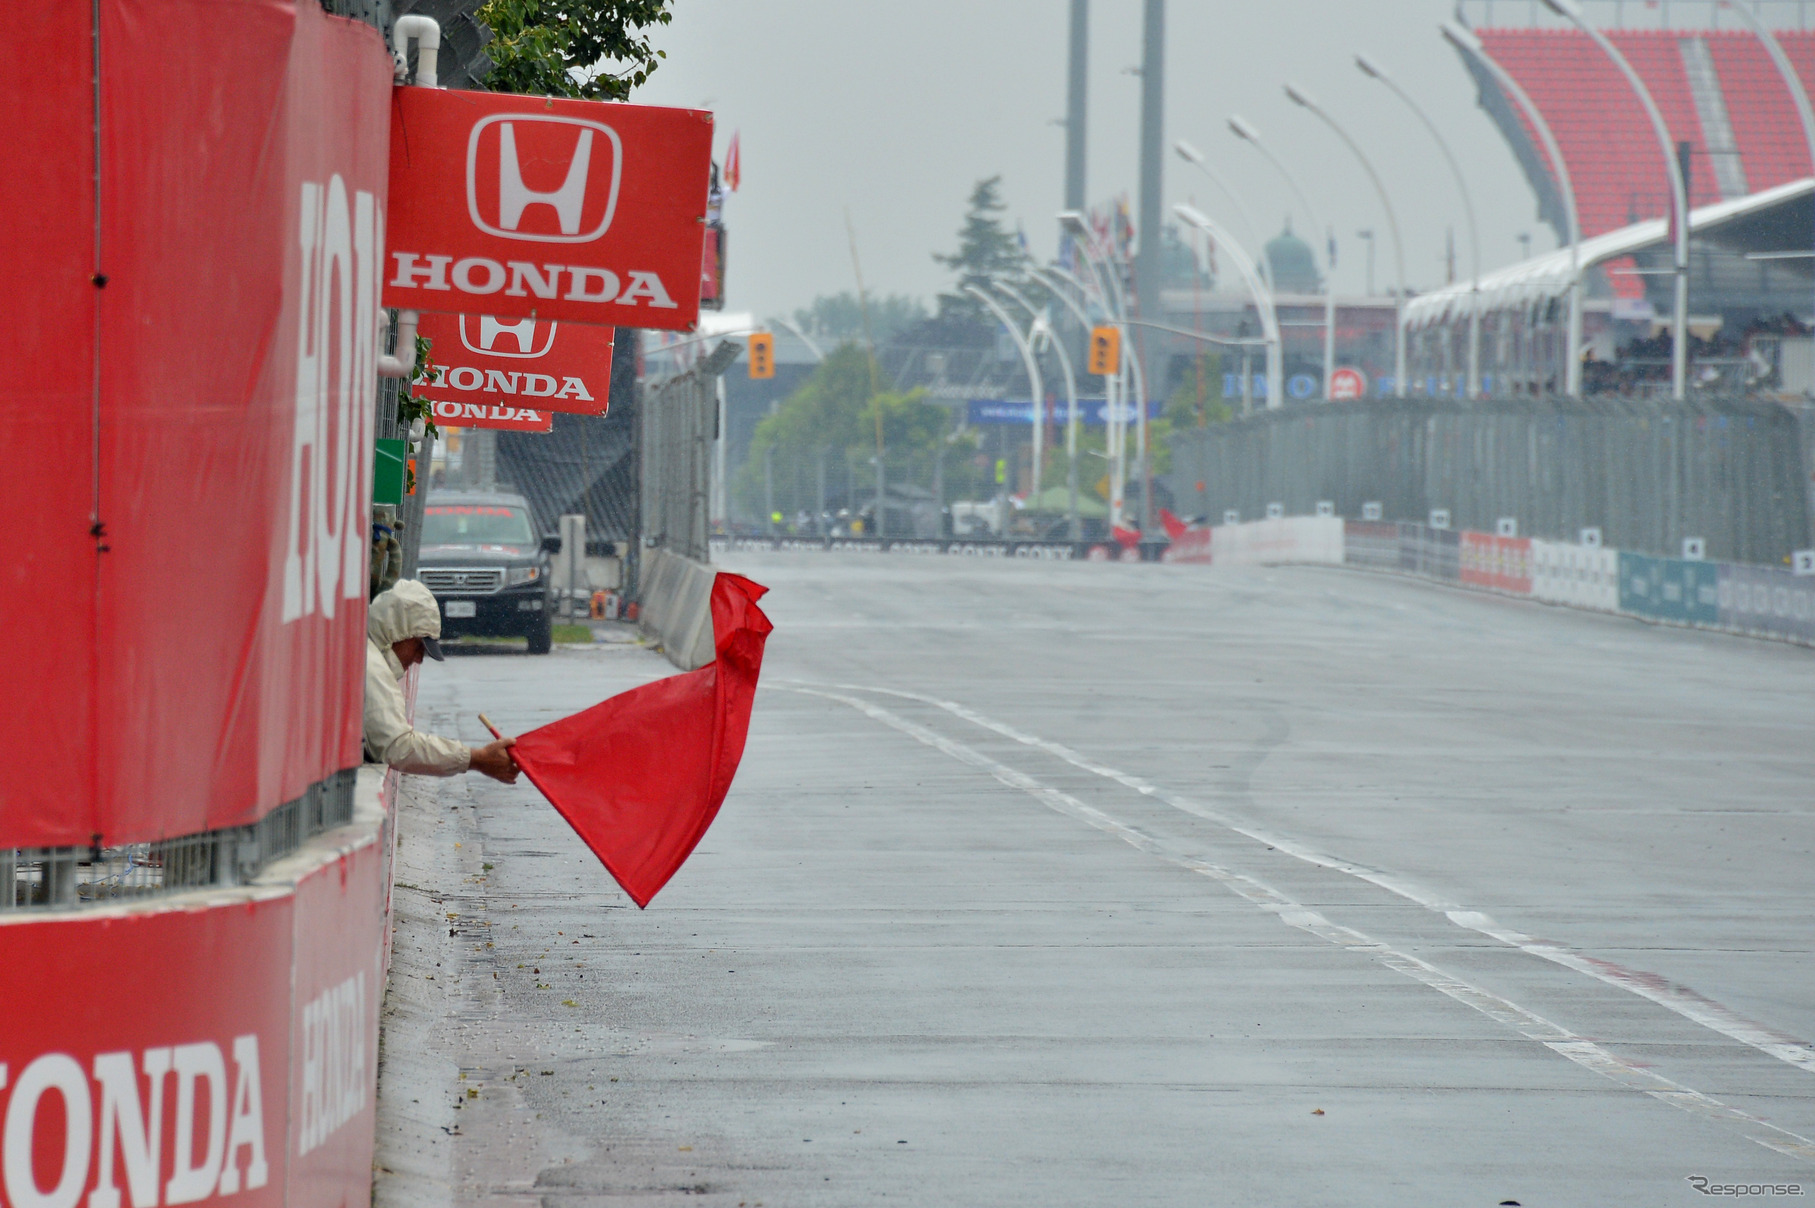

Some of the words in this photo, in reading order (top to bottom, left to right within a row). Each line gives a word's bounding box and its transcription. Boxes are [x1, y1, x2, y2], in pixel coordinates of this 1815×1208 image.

[390, 252, 678, 309] HONDA
[412, 364, 595, 402] HONDA
[0, 1034, 269, 1208] ONDA
